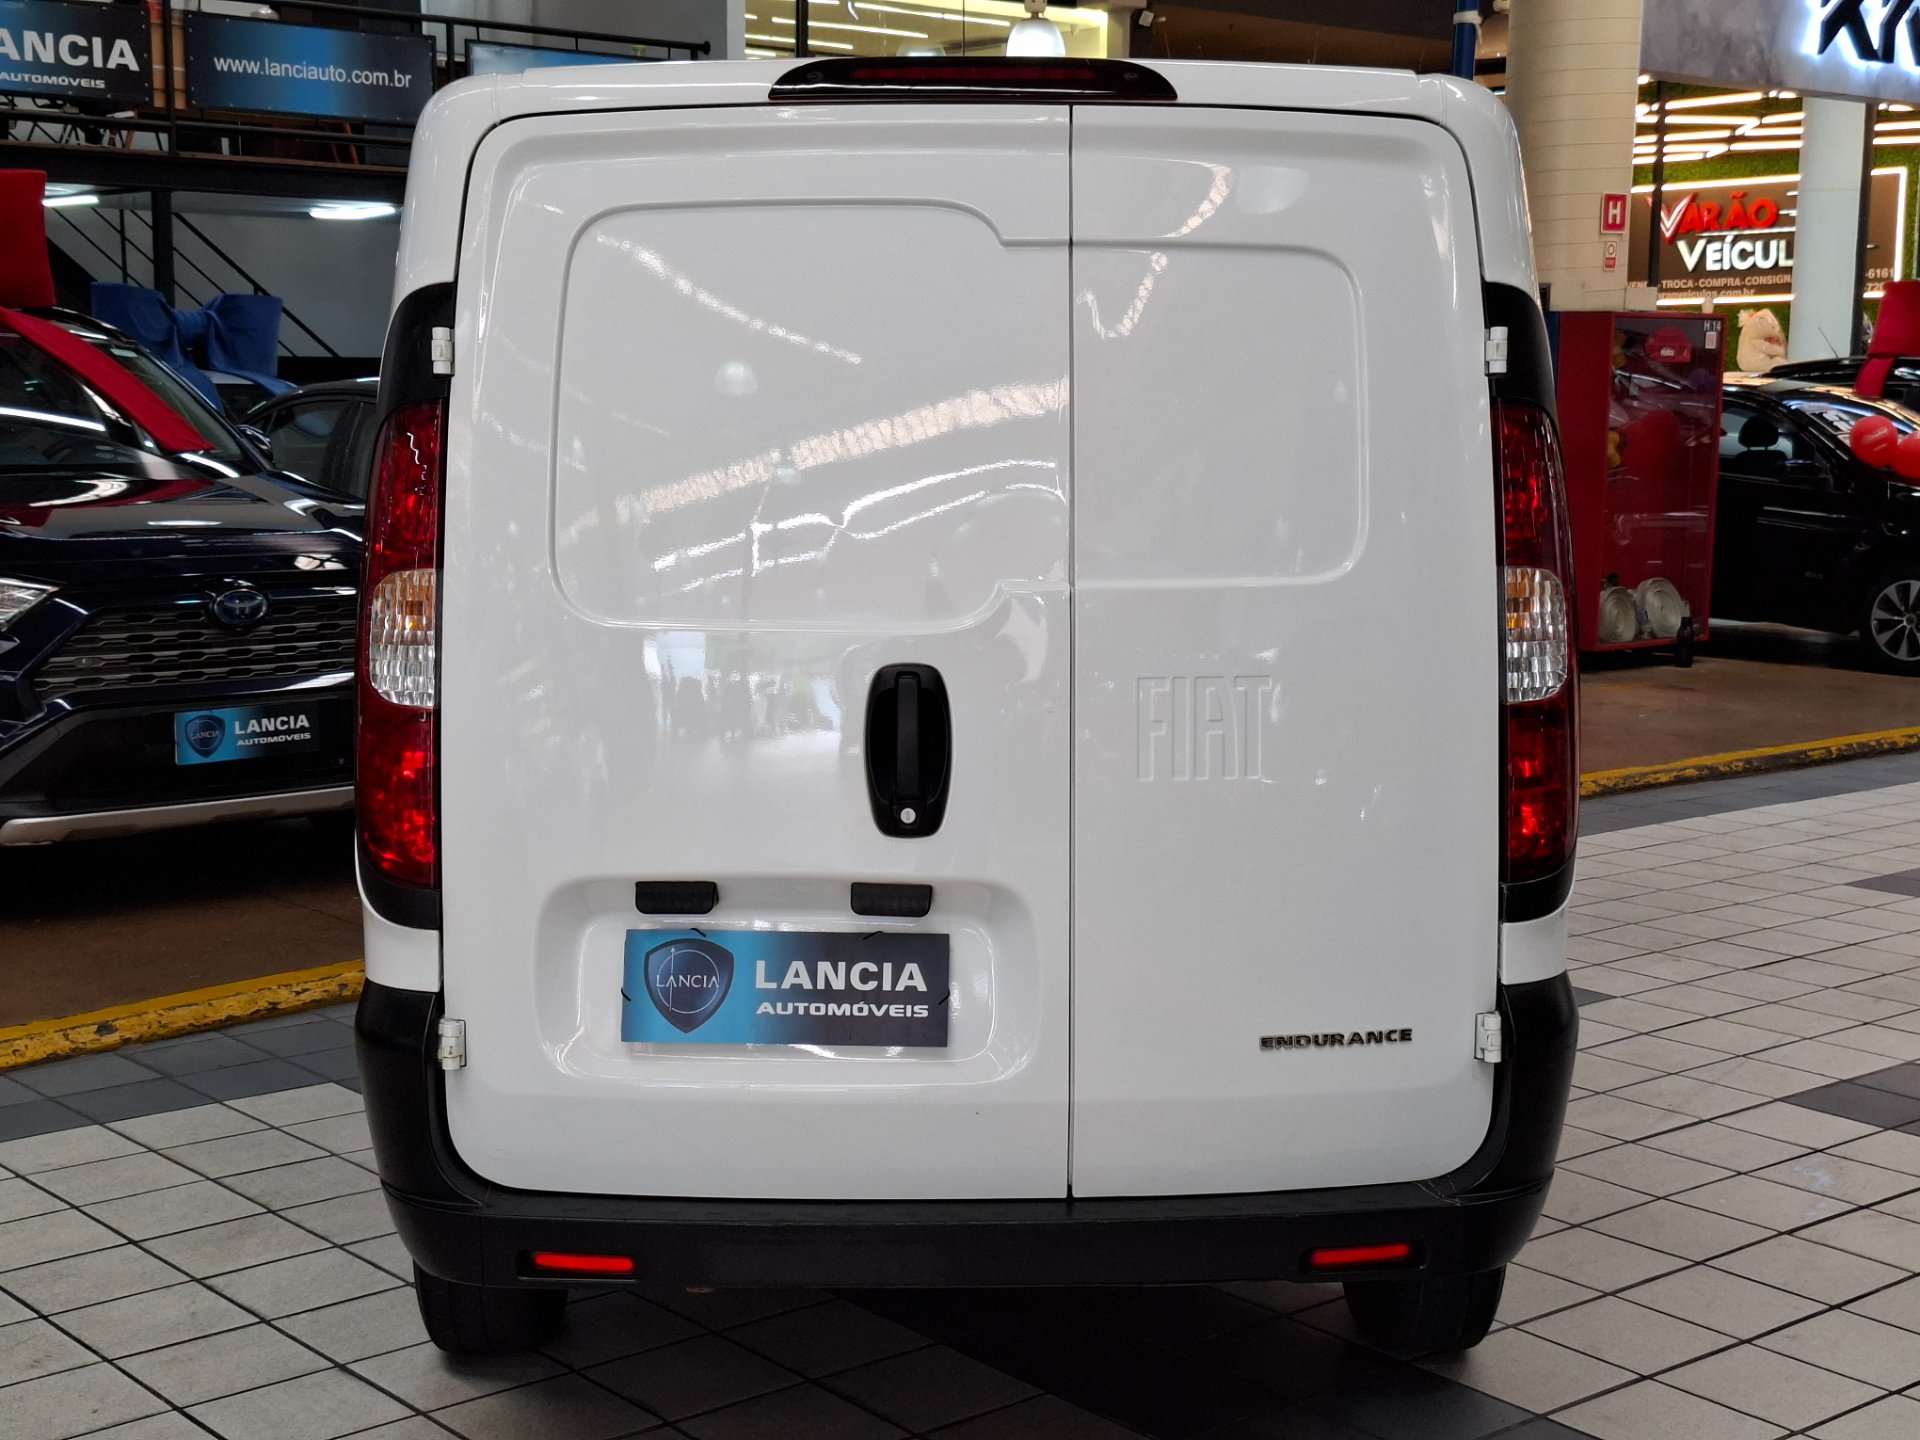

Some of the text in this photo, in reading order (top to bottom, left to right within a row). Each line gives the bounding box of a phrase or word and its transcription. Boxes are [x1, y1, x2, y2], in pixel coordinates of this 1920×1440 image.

[0, 27, 140, 72] ANCIA
[213, 56, 412, 88] www.lanciauto.com.br
[1608, 201, 1622, 225] H
[1676, 234, 1795, 273] VEÍCUL
[1745, 274, 1792, 286] CONSIGN
[234, 714, 310, 735] LANCIA
[1137, 675, 1272, 781] FIAT
[656, 973, 720, 989] LANCIA
[755, 960, 928, 992] LANCIA
[756, 1001, 929, 1018] AUTOMÓVEIS
[1259, 1028, 1413, 1050] ENDURANCE
